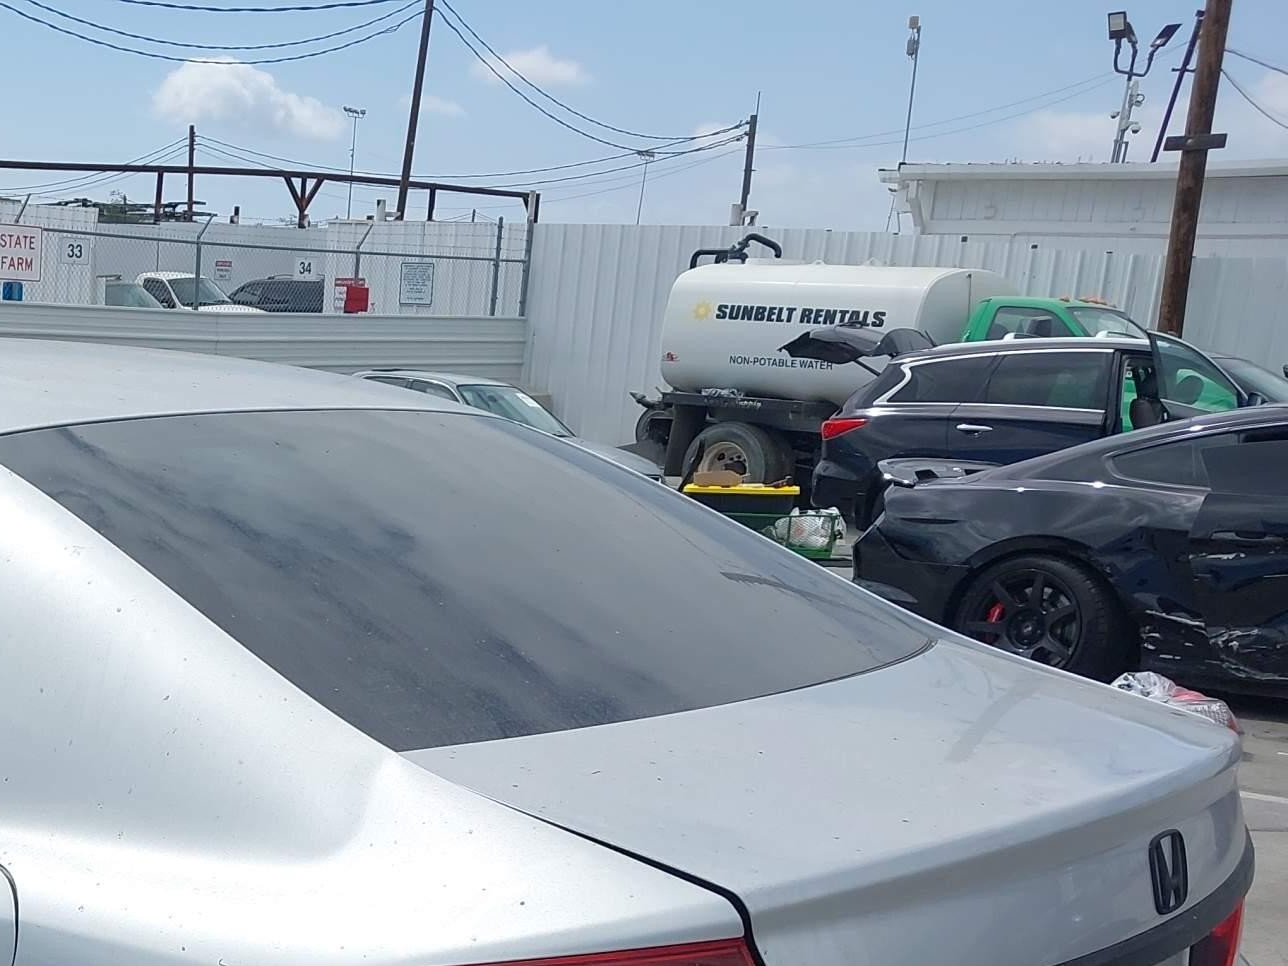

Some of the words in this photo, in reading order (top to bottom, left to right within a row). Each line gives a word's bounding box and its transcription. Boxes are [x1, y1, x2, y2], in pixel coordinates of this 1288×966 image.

[0, 233, 36, 250] STATE
[67, 244, 83, 258] 33
[0, 255, 33, 272] FARM
[299, 261, 312, 275] 34
[715, 304, 797, 323] SUNBELT
[799, 307, 887, 328] RENTALS
[729, 355, 797, 369] NON-POTABLE
[799, 360, 833, 371] WATER
